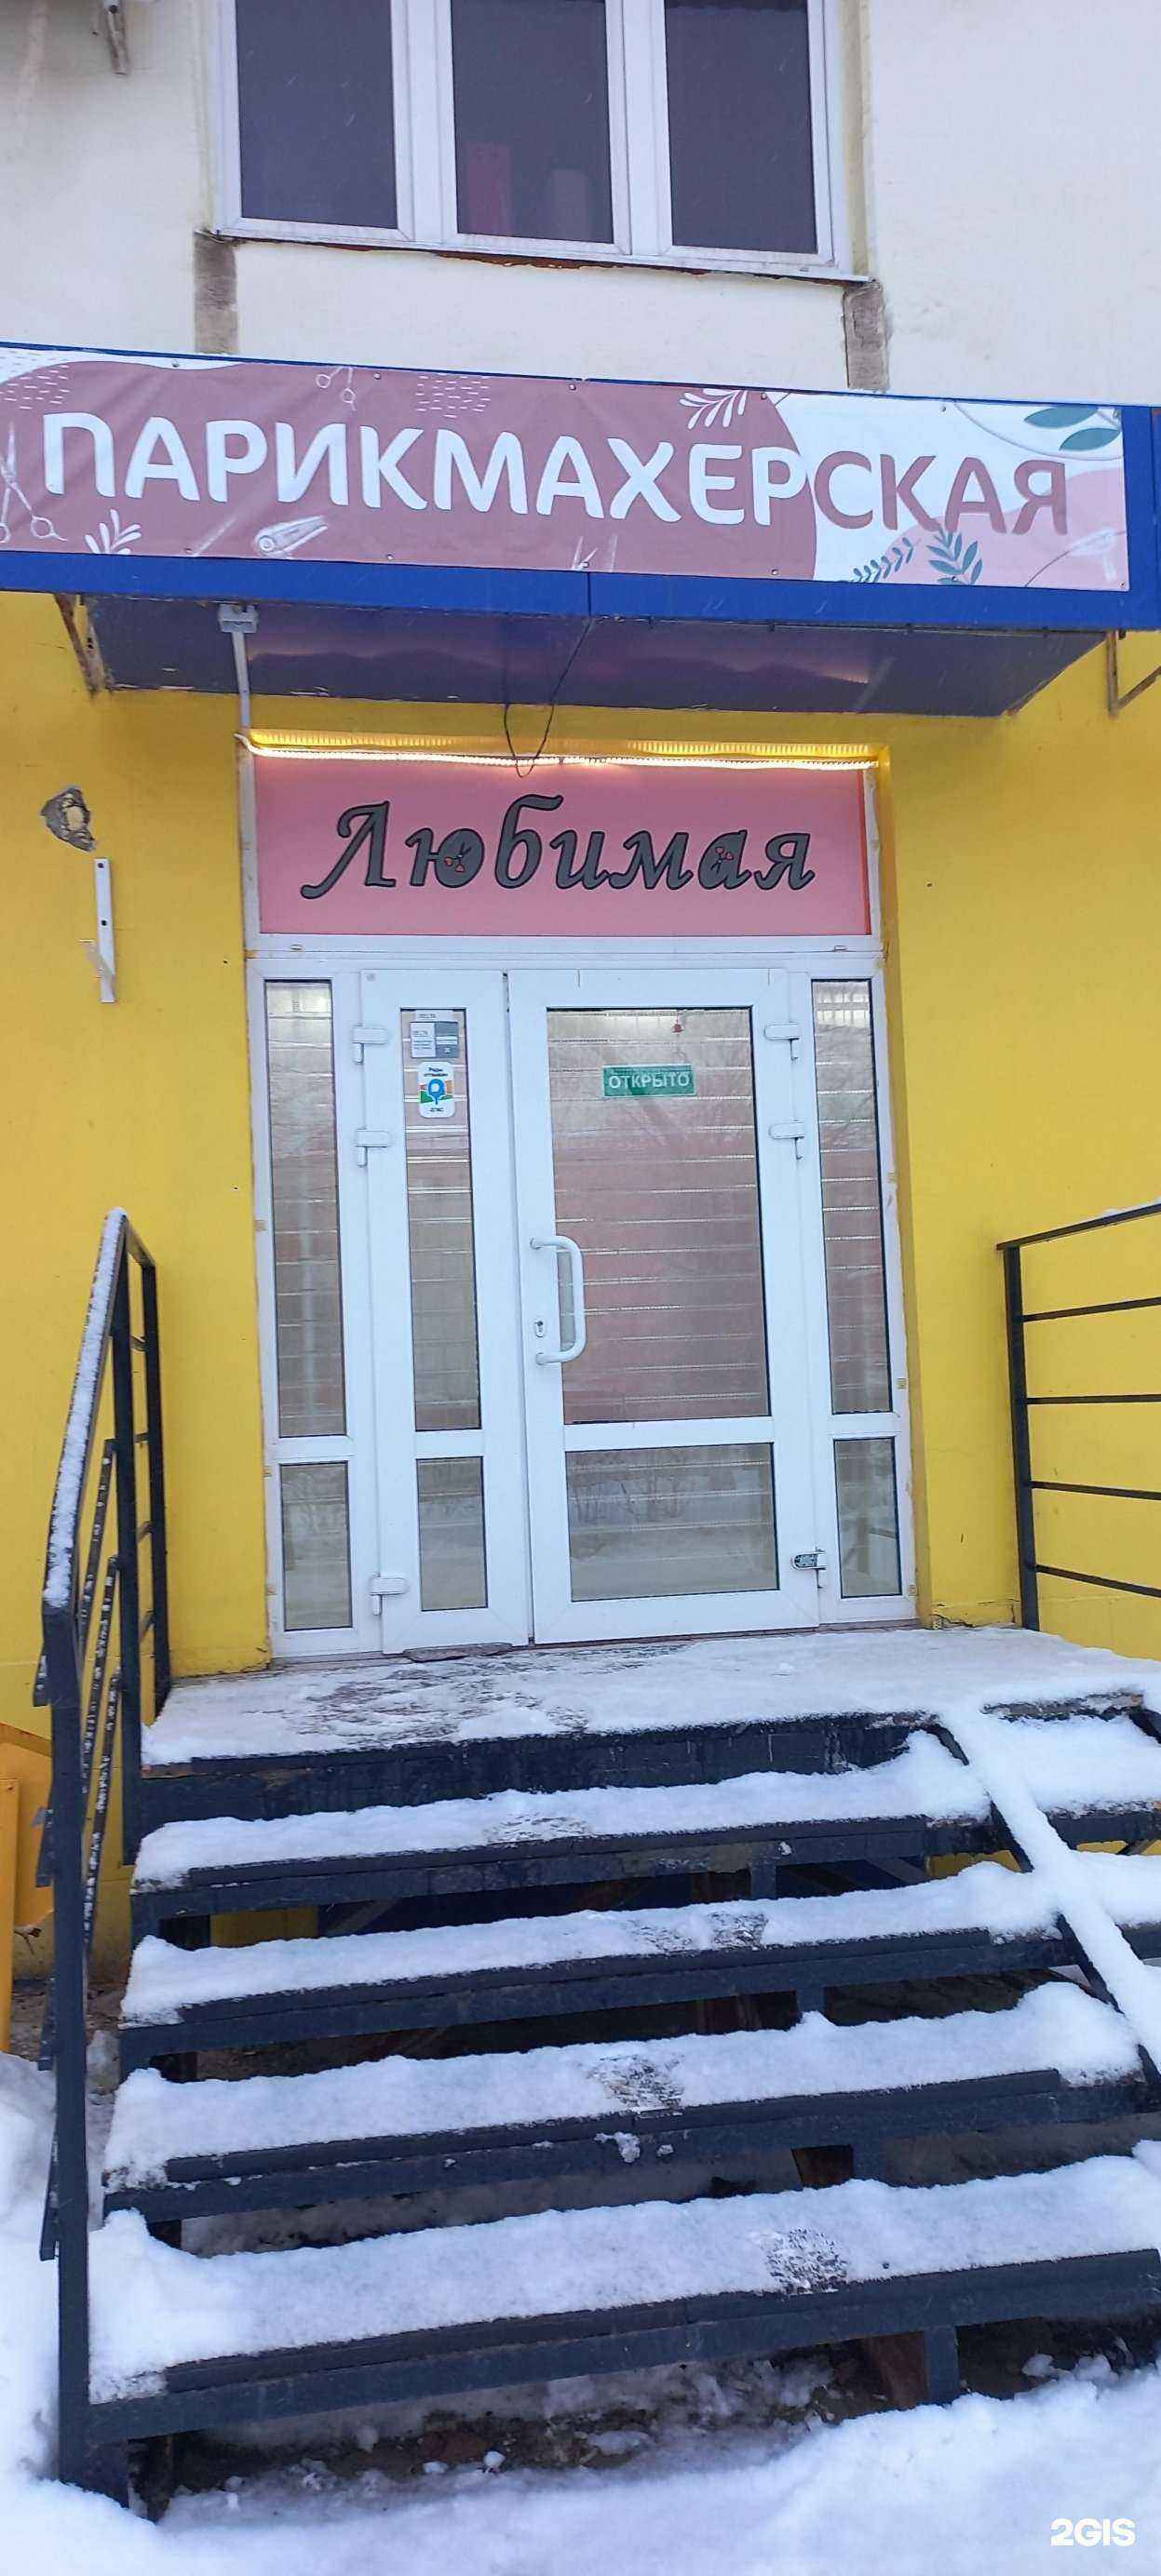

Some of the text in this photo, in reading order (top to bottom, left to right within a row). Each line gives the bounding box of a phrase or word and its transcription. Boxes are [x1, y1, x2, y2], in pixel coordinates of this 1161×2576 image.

[43, 411, 1068, 537] ПАРИКМАХЕРСКАЯ
[300, 794, 816, 899] Любимая
[608, 1071, 690, 1088] ОТКРЫТО
